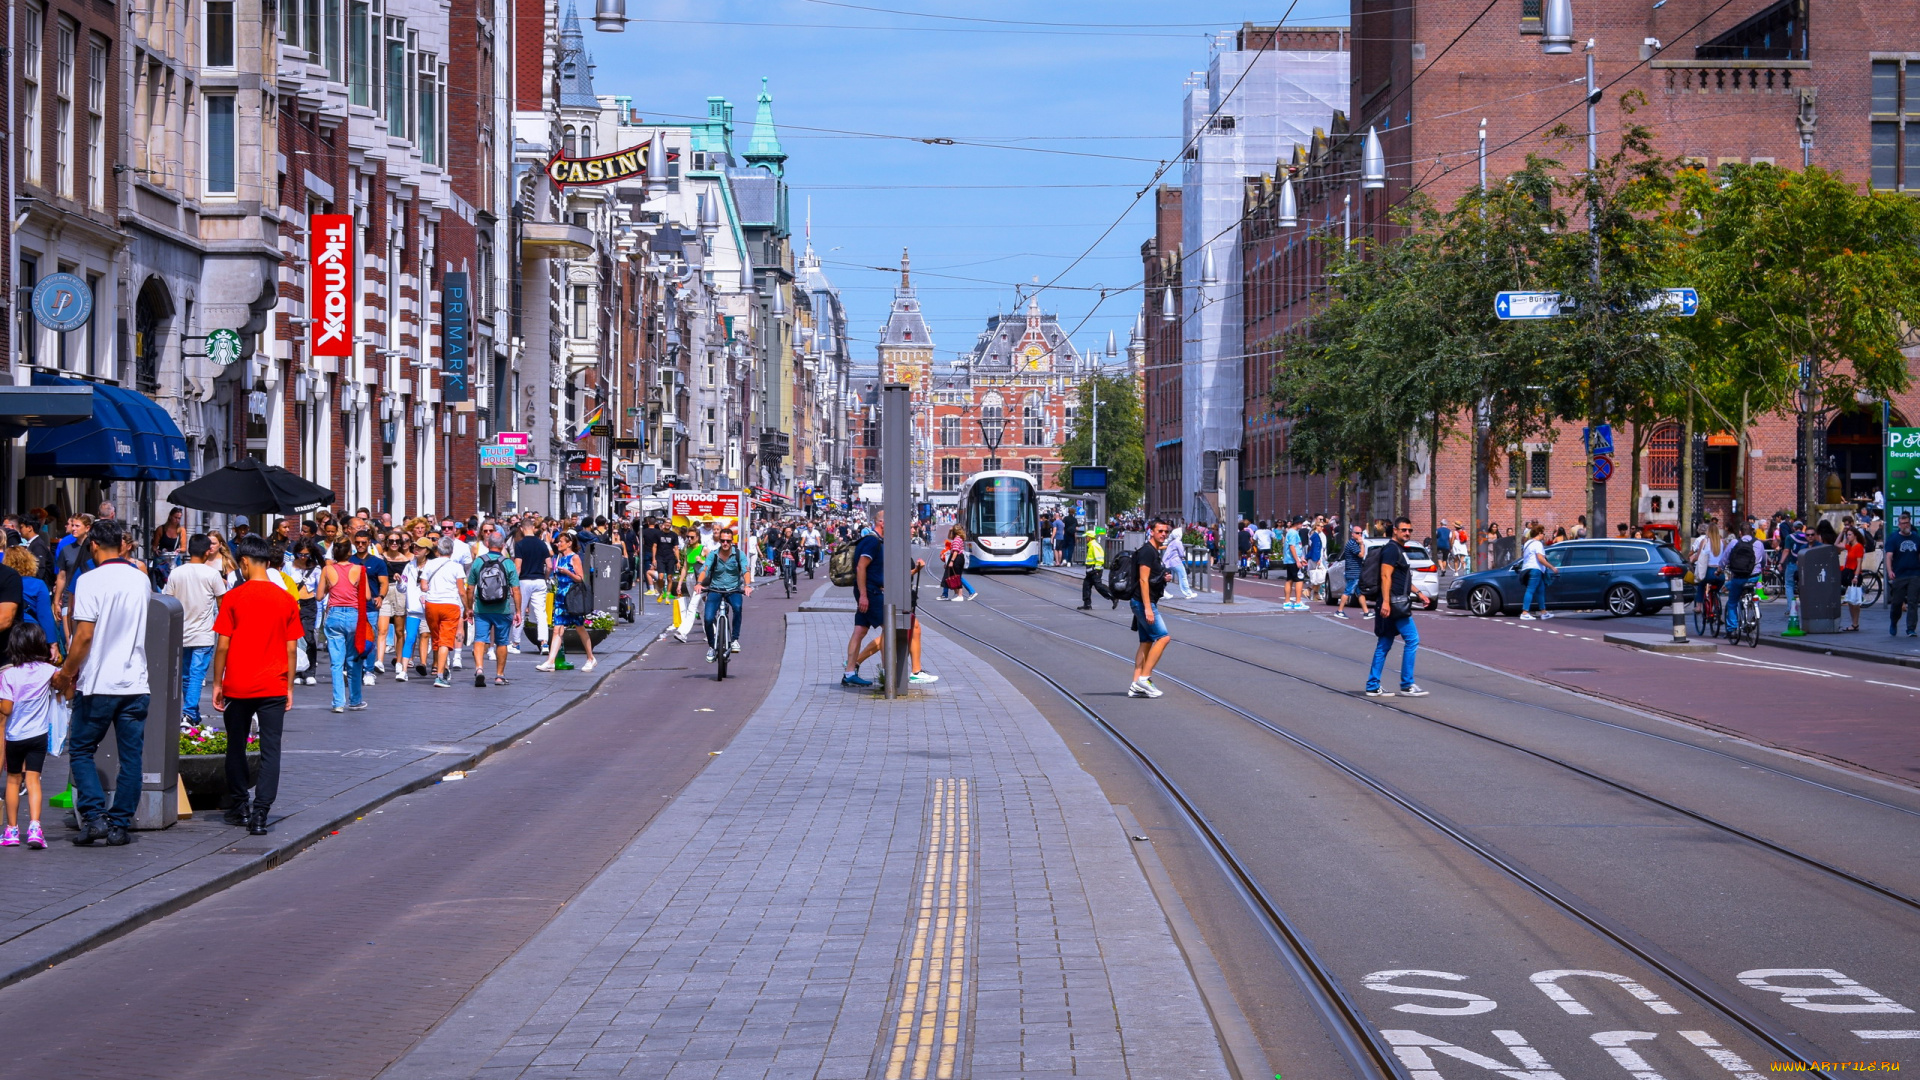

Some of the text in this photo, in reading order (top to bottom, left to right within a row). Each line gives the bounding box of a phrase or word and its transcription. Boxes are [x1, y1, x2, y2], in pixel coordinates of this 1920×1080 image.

[449, 287, 463, 386] PRIMARK
[1890, 433, 1902, 448] P
[482, 456, 513, 464] HOUSE
[674, 494, 718, 502] HOTDOGS
